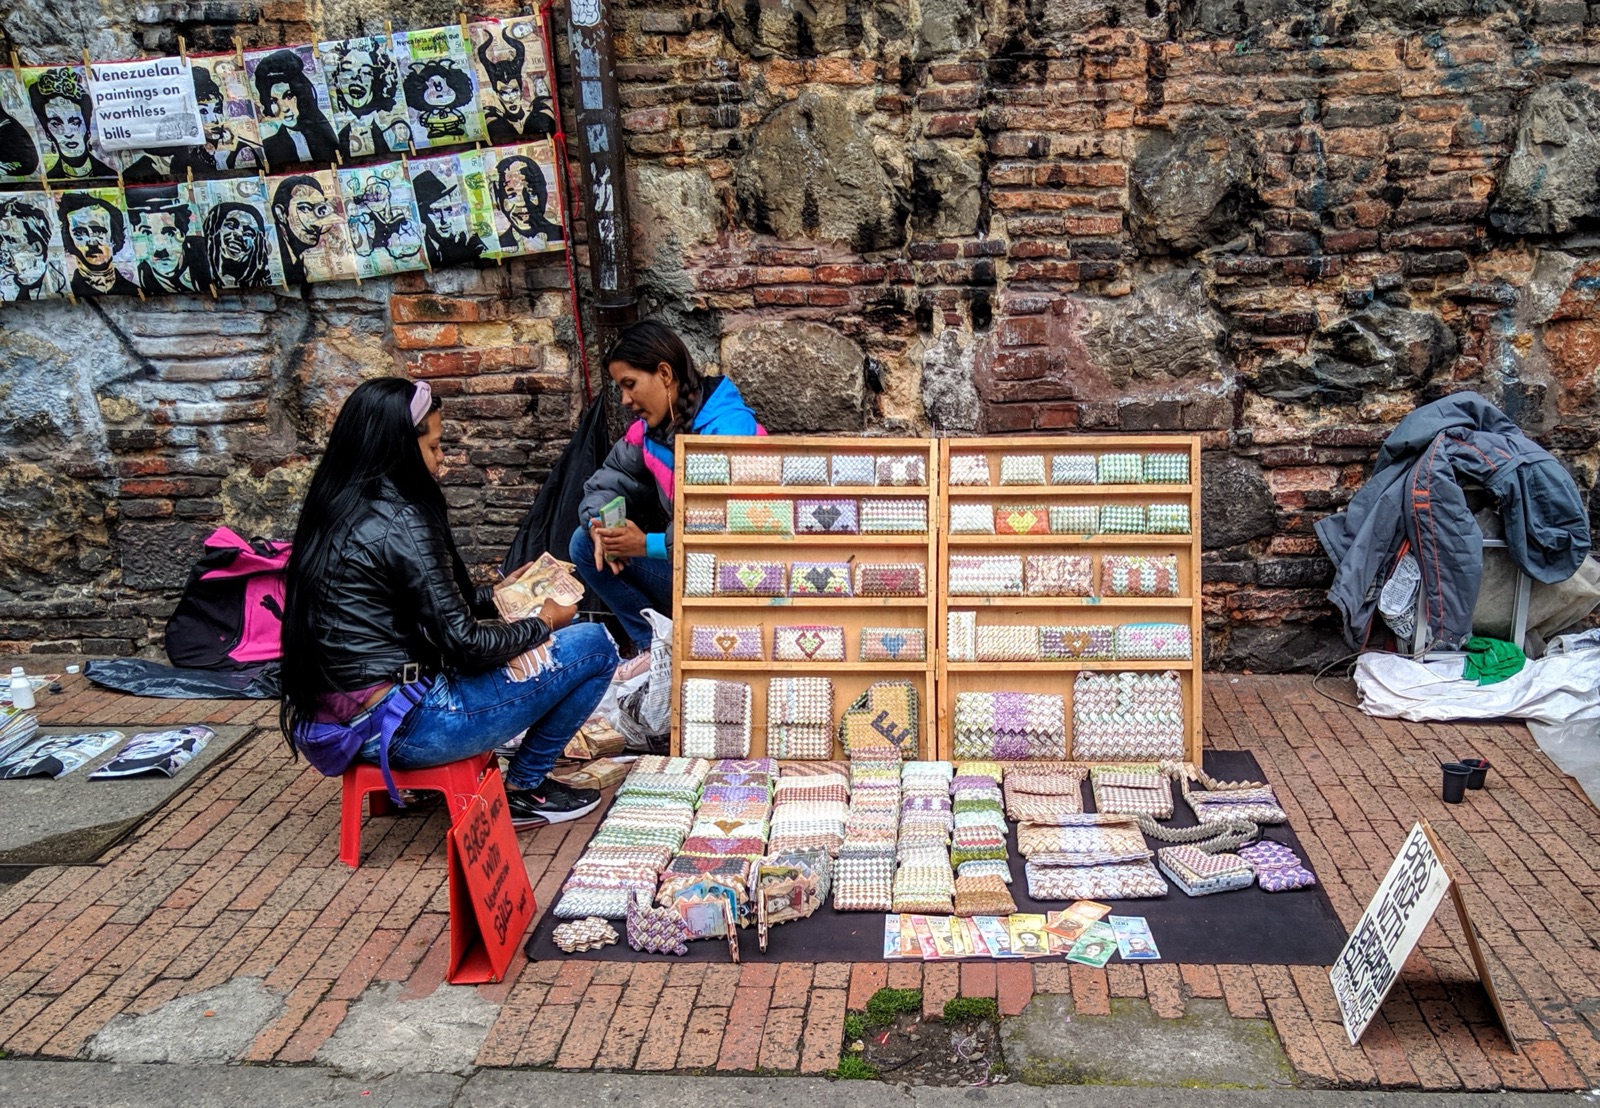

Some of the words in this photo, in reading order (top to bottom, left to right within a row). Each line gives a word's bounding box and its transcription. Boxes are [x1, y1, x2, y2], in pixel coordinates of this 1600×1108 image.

[91, 63, 180, 82] Venezuelan
[96, 87, 159, 105] paintings
[163, 86, 180, 95] on
[99, 105, 166, 120] worthless
[103, 126, 132, 140] bills
[481, 843, 501, 880] WITH
[1389, 864, 1421, 921] MADE
[1377, 892, 1406, 954] WITH
[1343, 935, 1371, 993] BILLS
[1354, 912, 1396, 997] VENEZUELAN
